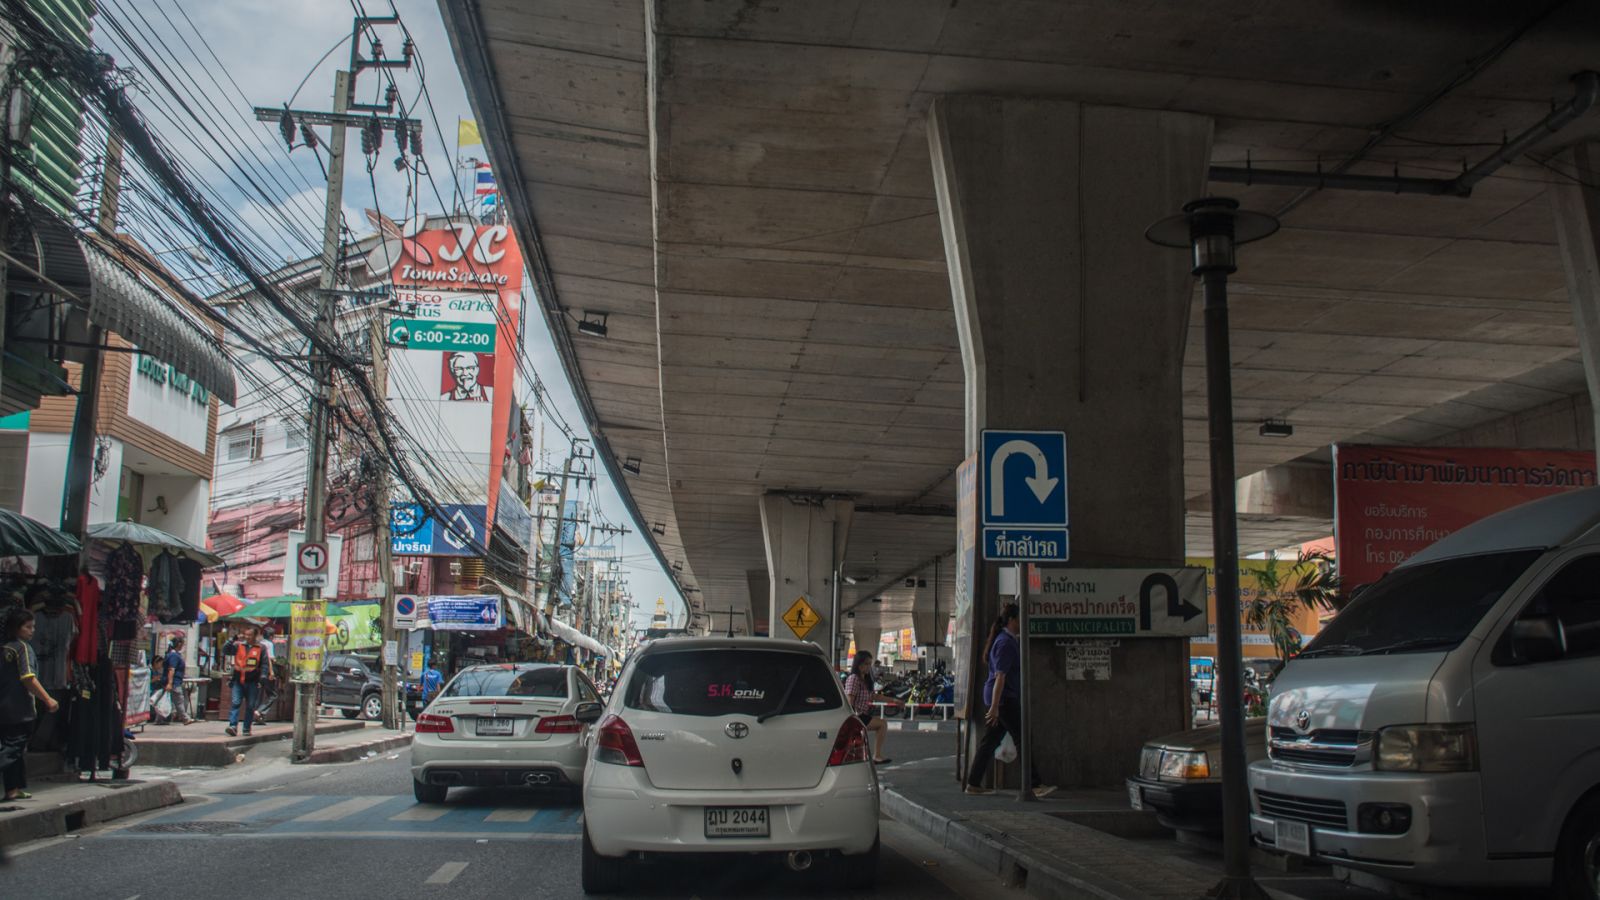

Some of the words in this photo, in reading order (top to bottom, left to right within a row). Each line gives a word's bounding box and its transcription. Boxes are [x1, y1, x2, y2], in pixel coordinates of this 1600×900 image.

[438, 222, 508, 264] JC
[402, 265, 508, 285] TownSquare
[398, 292, 442, 303] TESCO
[994, 530, 1058, 557] ที่กลับรถ
[1043, 575, 1096, 593] สำนักงาน
[1056, 621, 1135, 634] MUNICIPALITY
[733, 810, 765, 824] 2044
